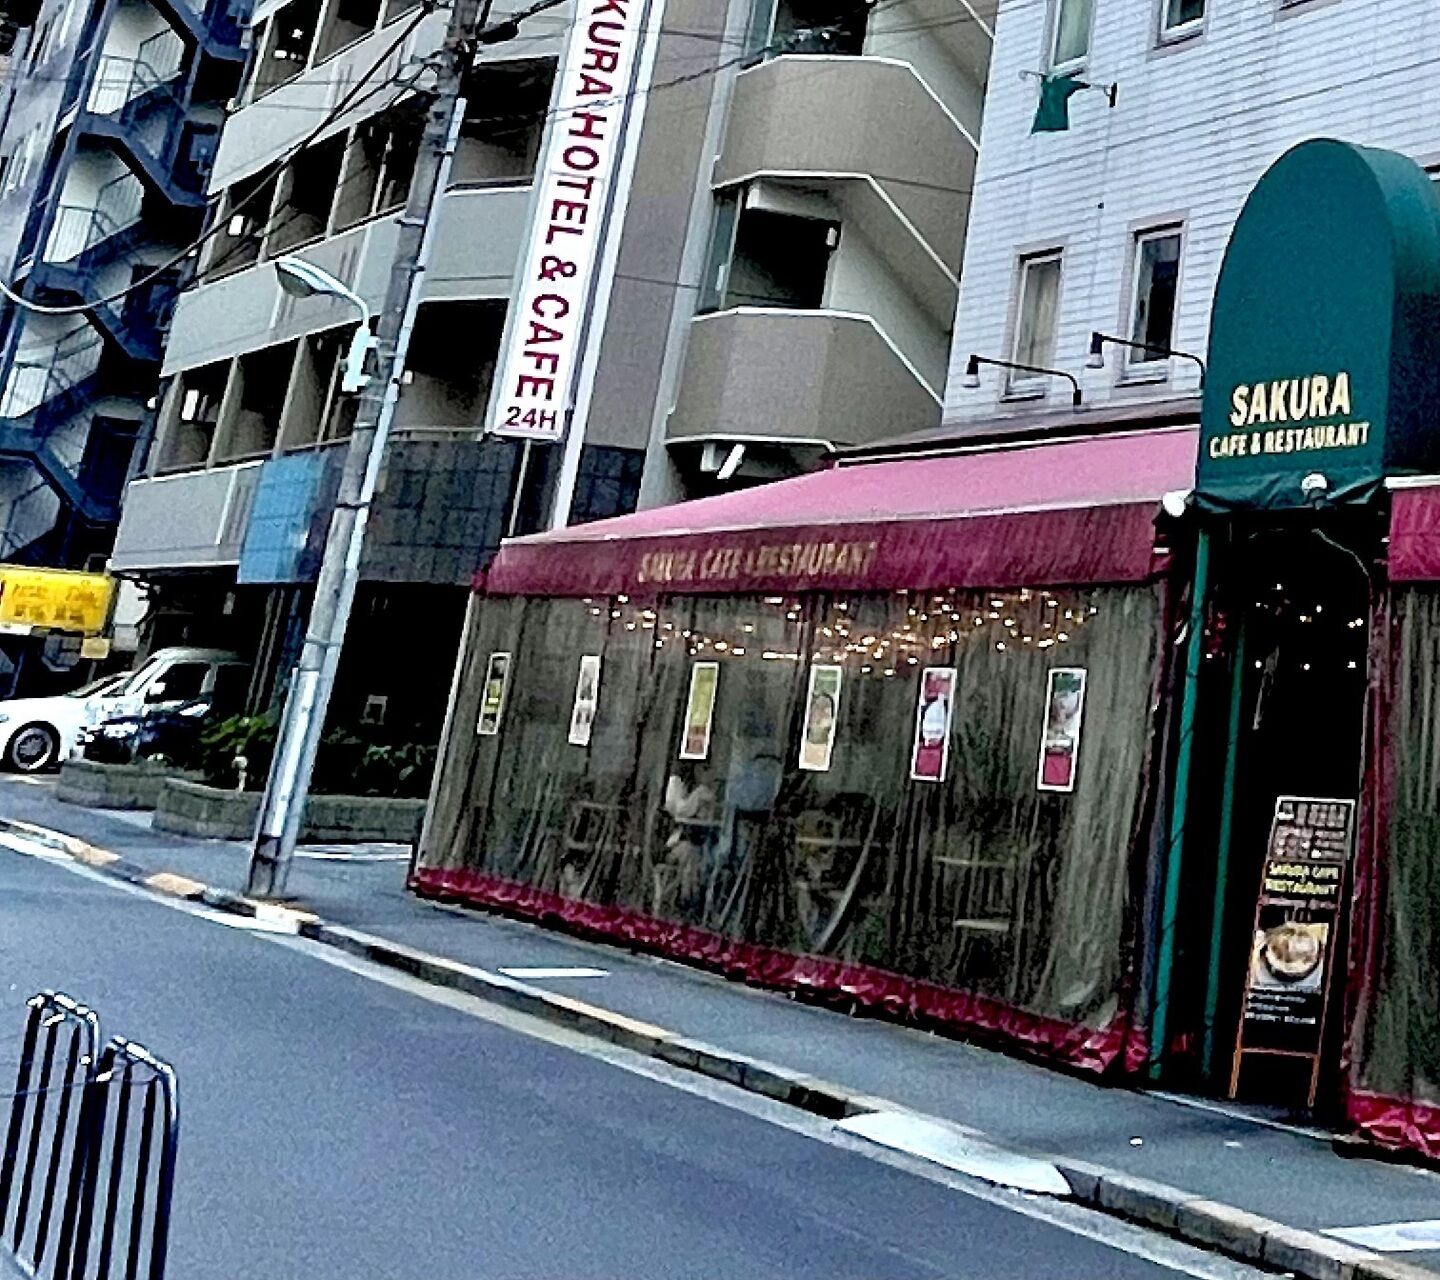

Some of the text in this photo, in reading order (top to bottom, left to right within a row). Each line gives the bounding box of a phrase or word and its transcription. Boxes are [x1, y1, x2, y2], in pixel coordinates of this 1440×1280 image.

[545, 111, 607, 245] HOTEL
[537, 254, 578, 282] &
[514, 293, 570, 401] CAFE
[504, 405, 558, 431] 24H
[1229, 371, 1351, 428] SAKURA
[1209, 421, 1370, 459] CAFE & RESTAURANT
